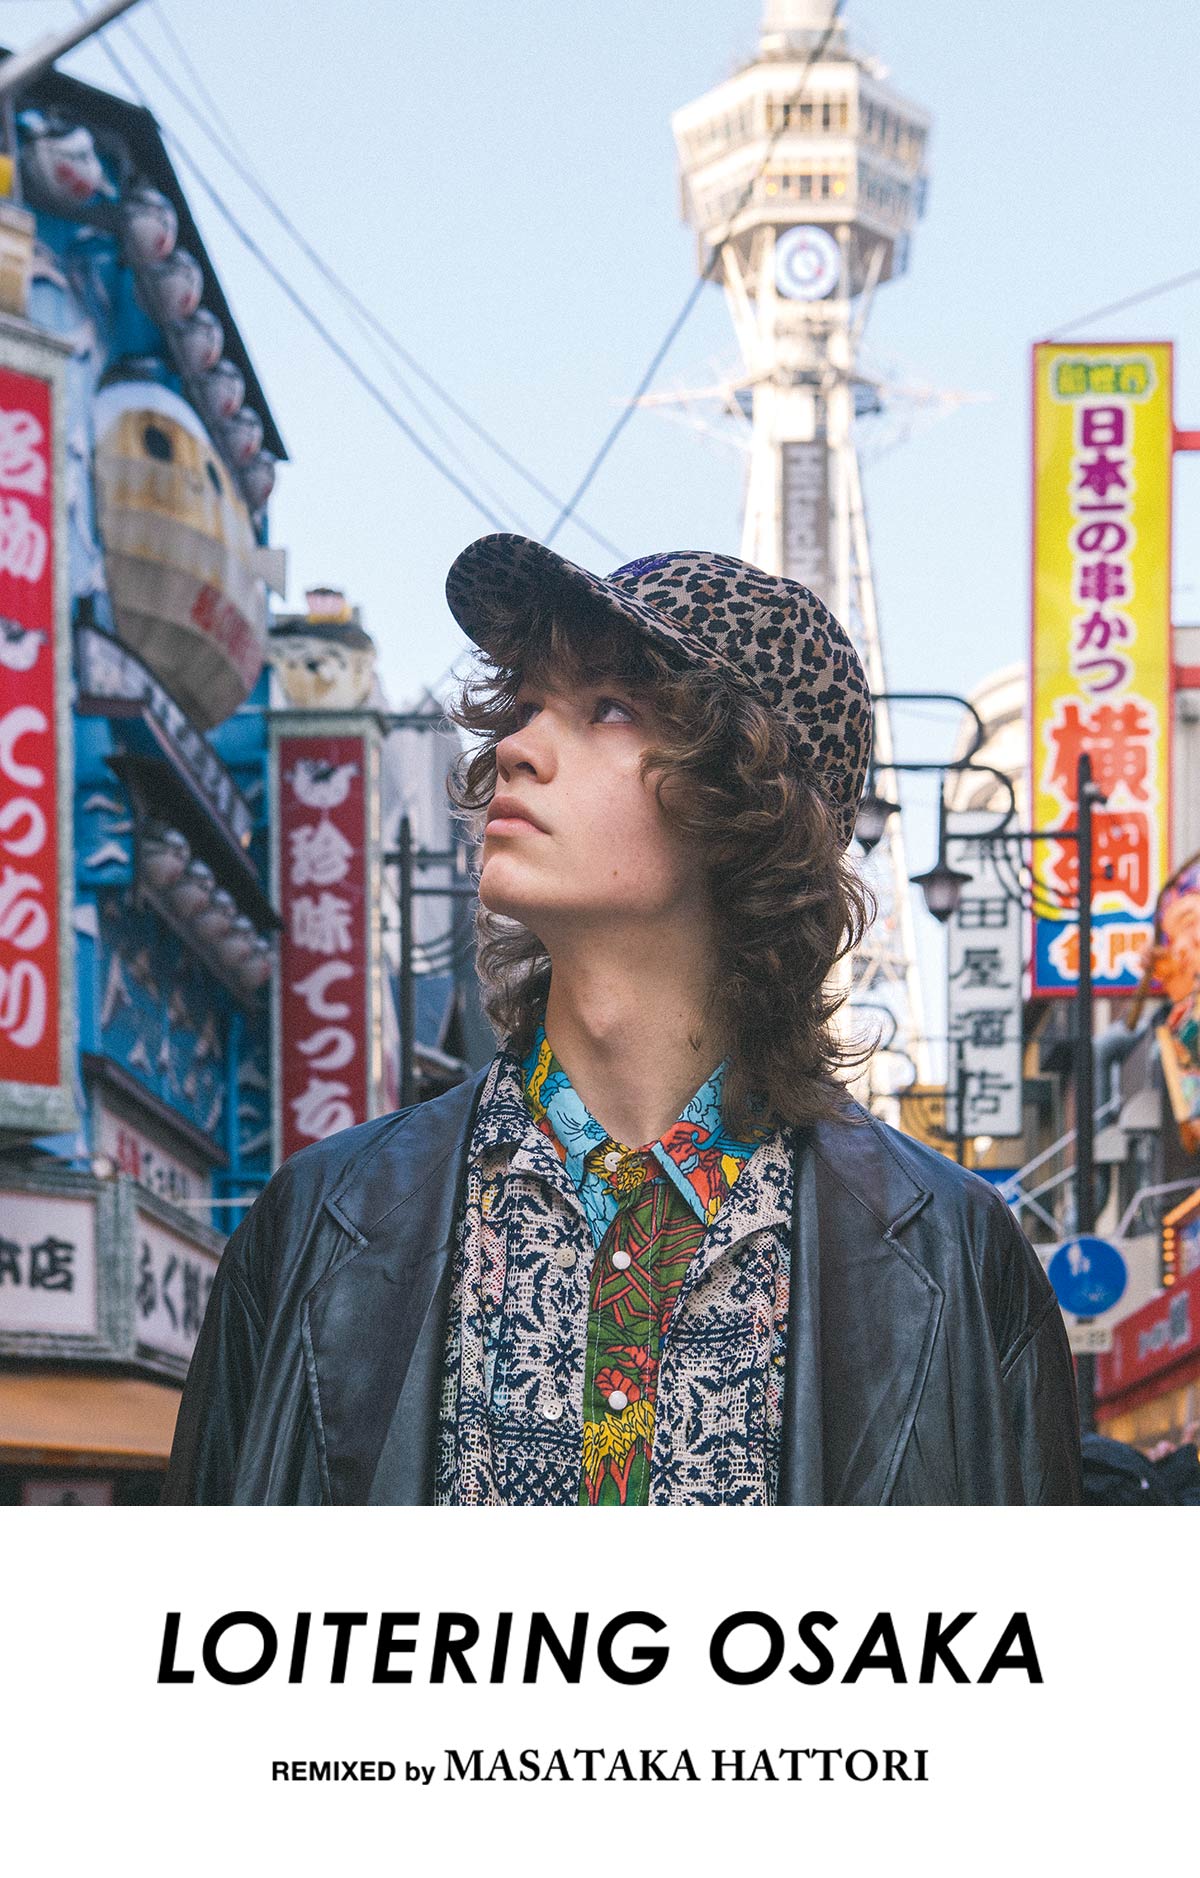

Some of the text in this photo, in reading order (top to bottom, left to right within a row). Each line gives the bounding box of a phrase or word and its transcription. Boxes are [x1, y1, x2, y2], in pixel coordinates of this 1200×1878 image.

[1076, 406, 1129, 692] 日本一の串かつ
[1049, 702, 1150, 910] 横綱
